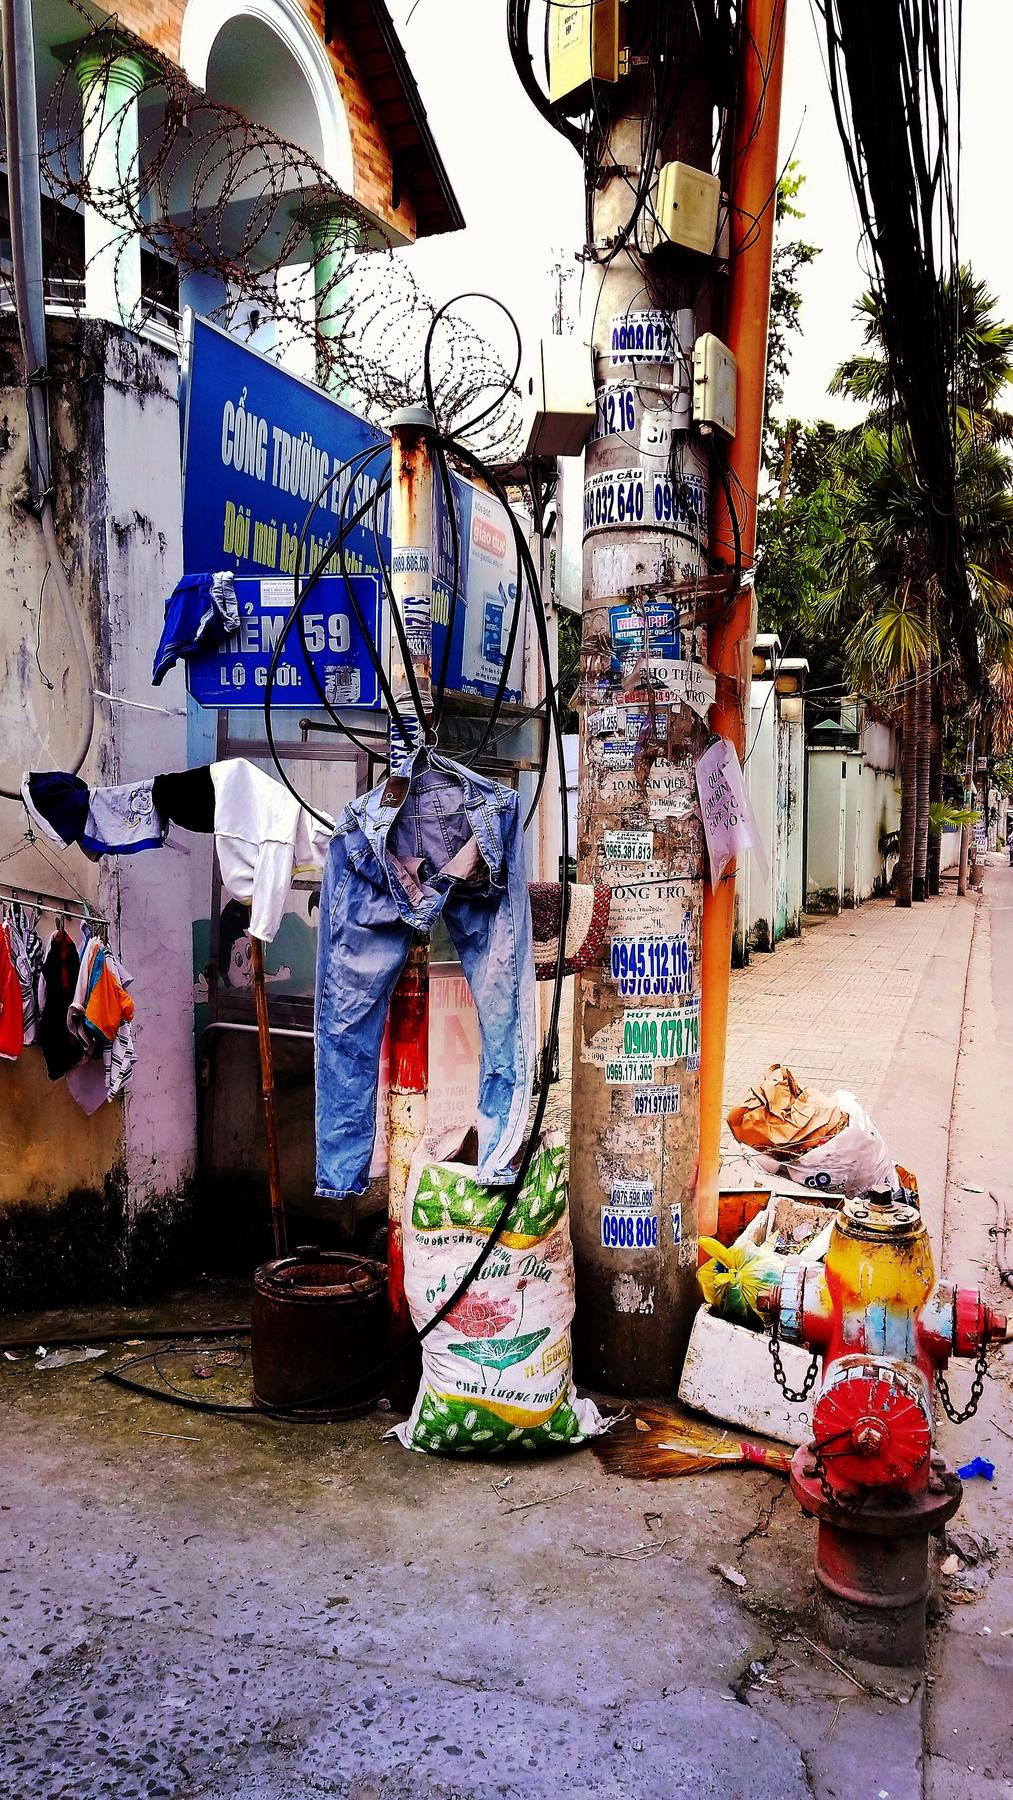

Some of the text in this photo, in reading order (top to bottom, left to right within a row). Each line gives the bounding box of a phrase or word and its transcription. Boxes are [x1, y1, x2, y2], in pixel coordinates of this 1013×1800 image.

[221, 386, 268, 481] CỔNG
[272, 425, 330, 509] TRƯỜNG
[616, 468, 642, 480] CẦU
[222, 500, 251, 567] Đội
[252, 518, 278, 568] mũ
[303, 614, 351, 652] 59
[220, 662, 246, 690] LỘ
[254, 662, 302, 686] GỚI:
[612, 941, 687, 978] 0945.112.116
[626, 1010, 652, 1018] HÚT
[606, 1064, 652, 1081] 0969.171.303
[634, 1094, 678, 1114] 0971.97.07.87
